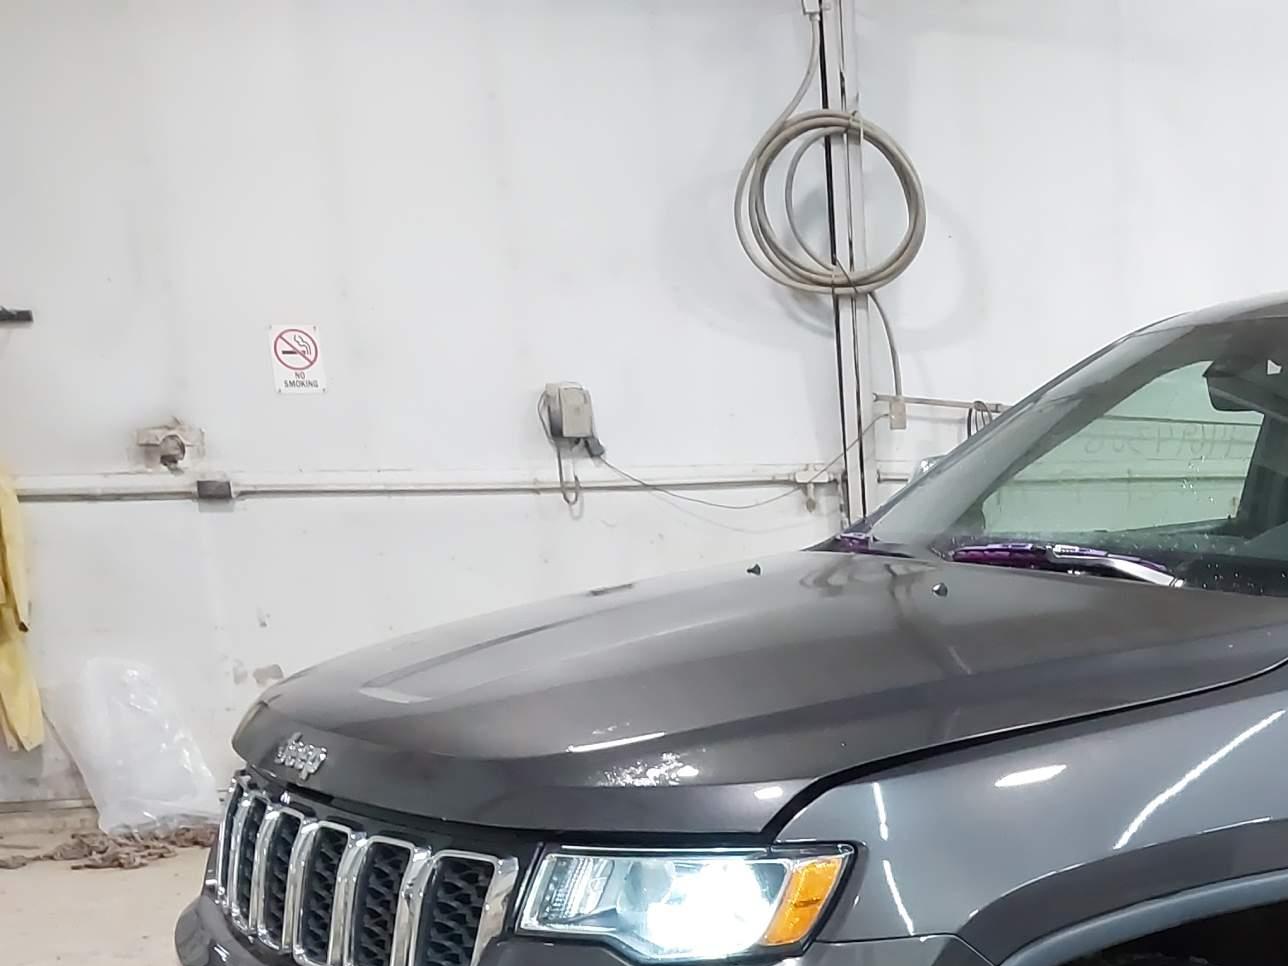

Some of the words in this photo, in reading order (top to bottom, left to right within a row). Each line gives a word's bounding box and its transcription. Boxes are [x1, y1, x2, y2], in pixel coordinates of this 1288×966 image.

[294, 371, 306, 380] NO
[284, 379, 319, 388] SMOKING
[274, 732, 327, 781] Jeep
